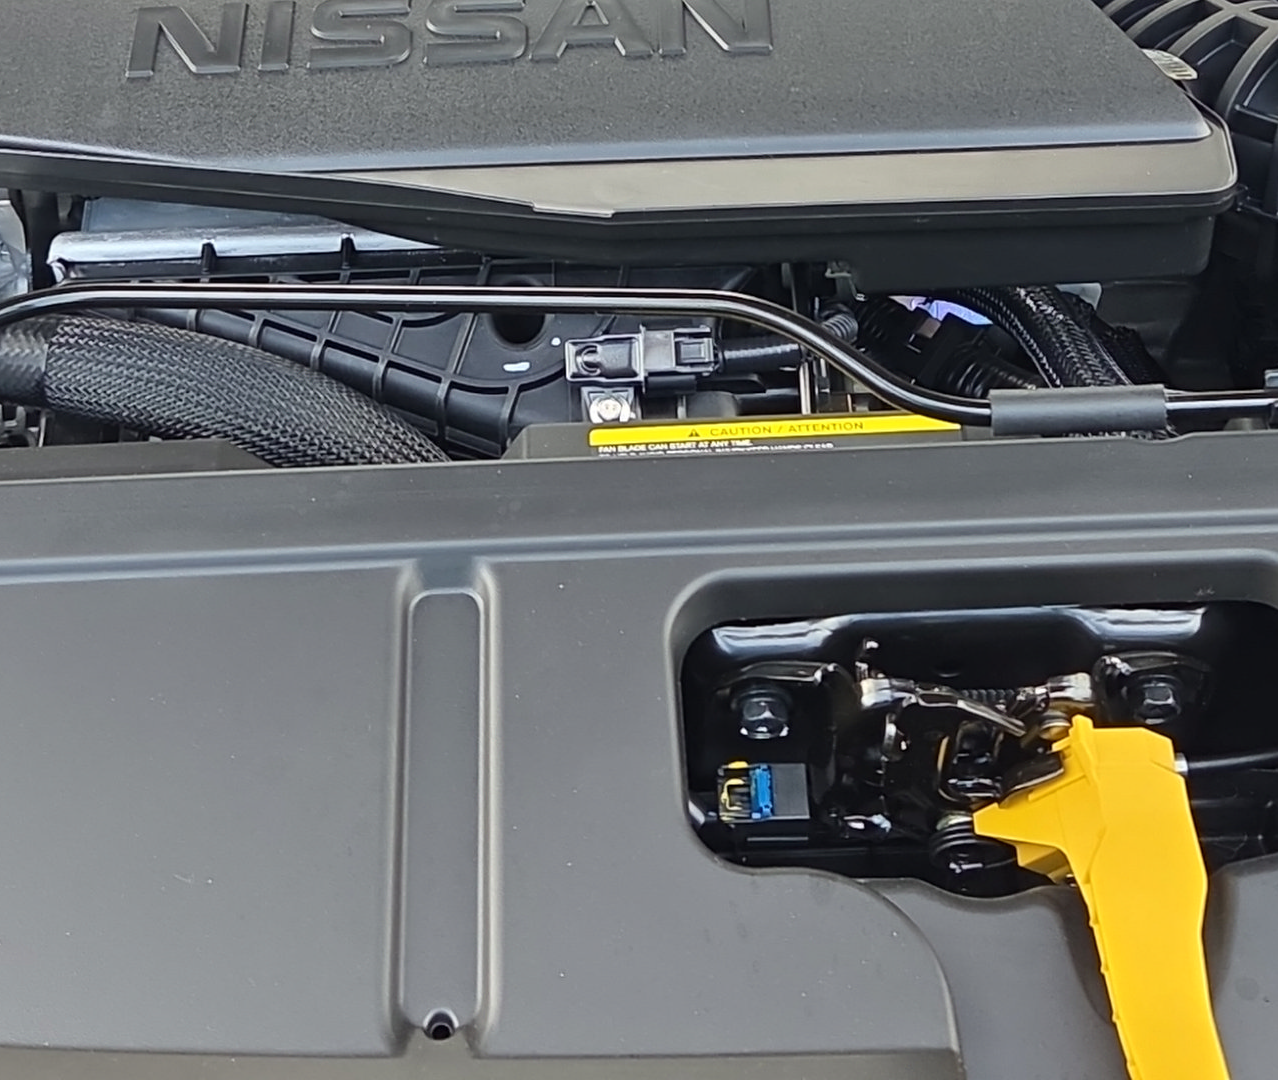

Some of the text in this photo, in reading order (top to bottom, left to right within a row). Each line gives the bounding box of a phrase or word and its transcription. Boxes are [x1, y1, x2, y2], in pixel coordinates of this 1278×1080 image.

[710, 425, 772, 437] CAUTION
[788, 422, 864, 434] ATTENTION
[598, 445, 617, 453] FAN
[617, 443, 647, 452] BLADE
[648, 442, 668, 451] CAN
[669, 441, 697, 449] START
[698, 440, 709, 448] AT
[710, 440, 730, 448] ANY
[731, 439, 754, 447] TIME.
